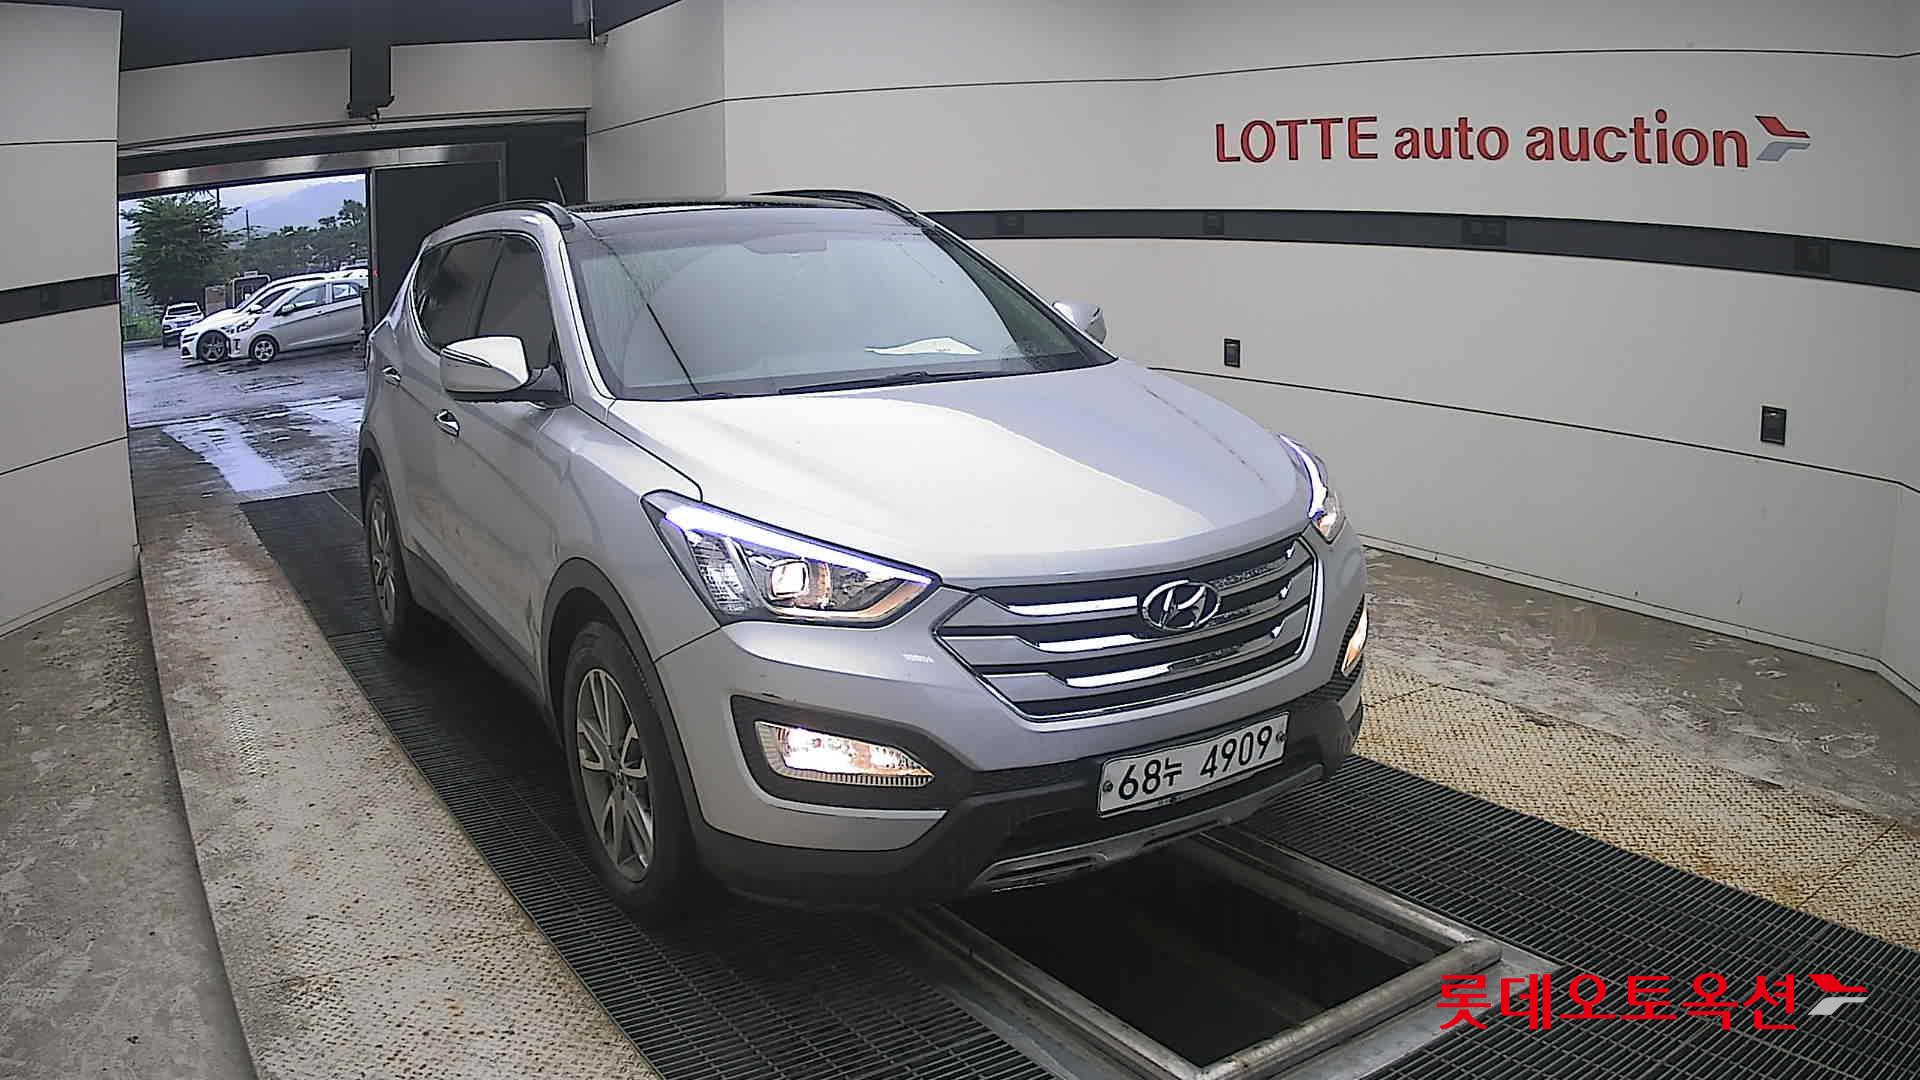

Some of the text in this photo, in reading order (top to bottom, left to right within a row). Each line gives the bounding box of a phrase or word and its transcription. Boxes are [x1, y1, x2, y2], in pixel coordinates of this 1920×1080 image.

[1215, 109, 1750, 168] LOTTE auto auction
[1118, 725, 1274, 800] 68누 4909
